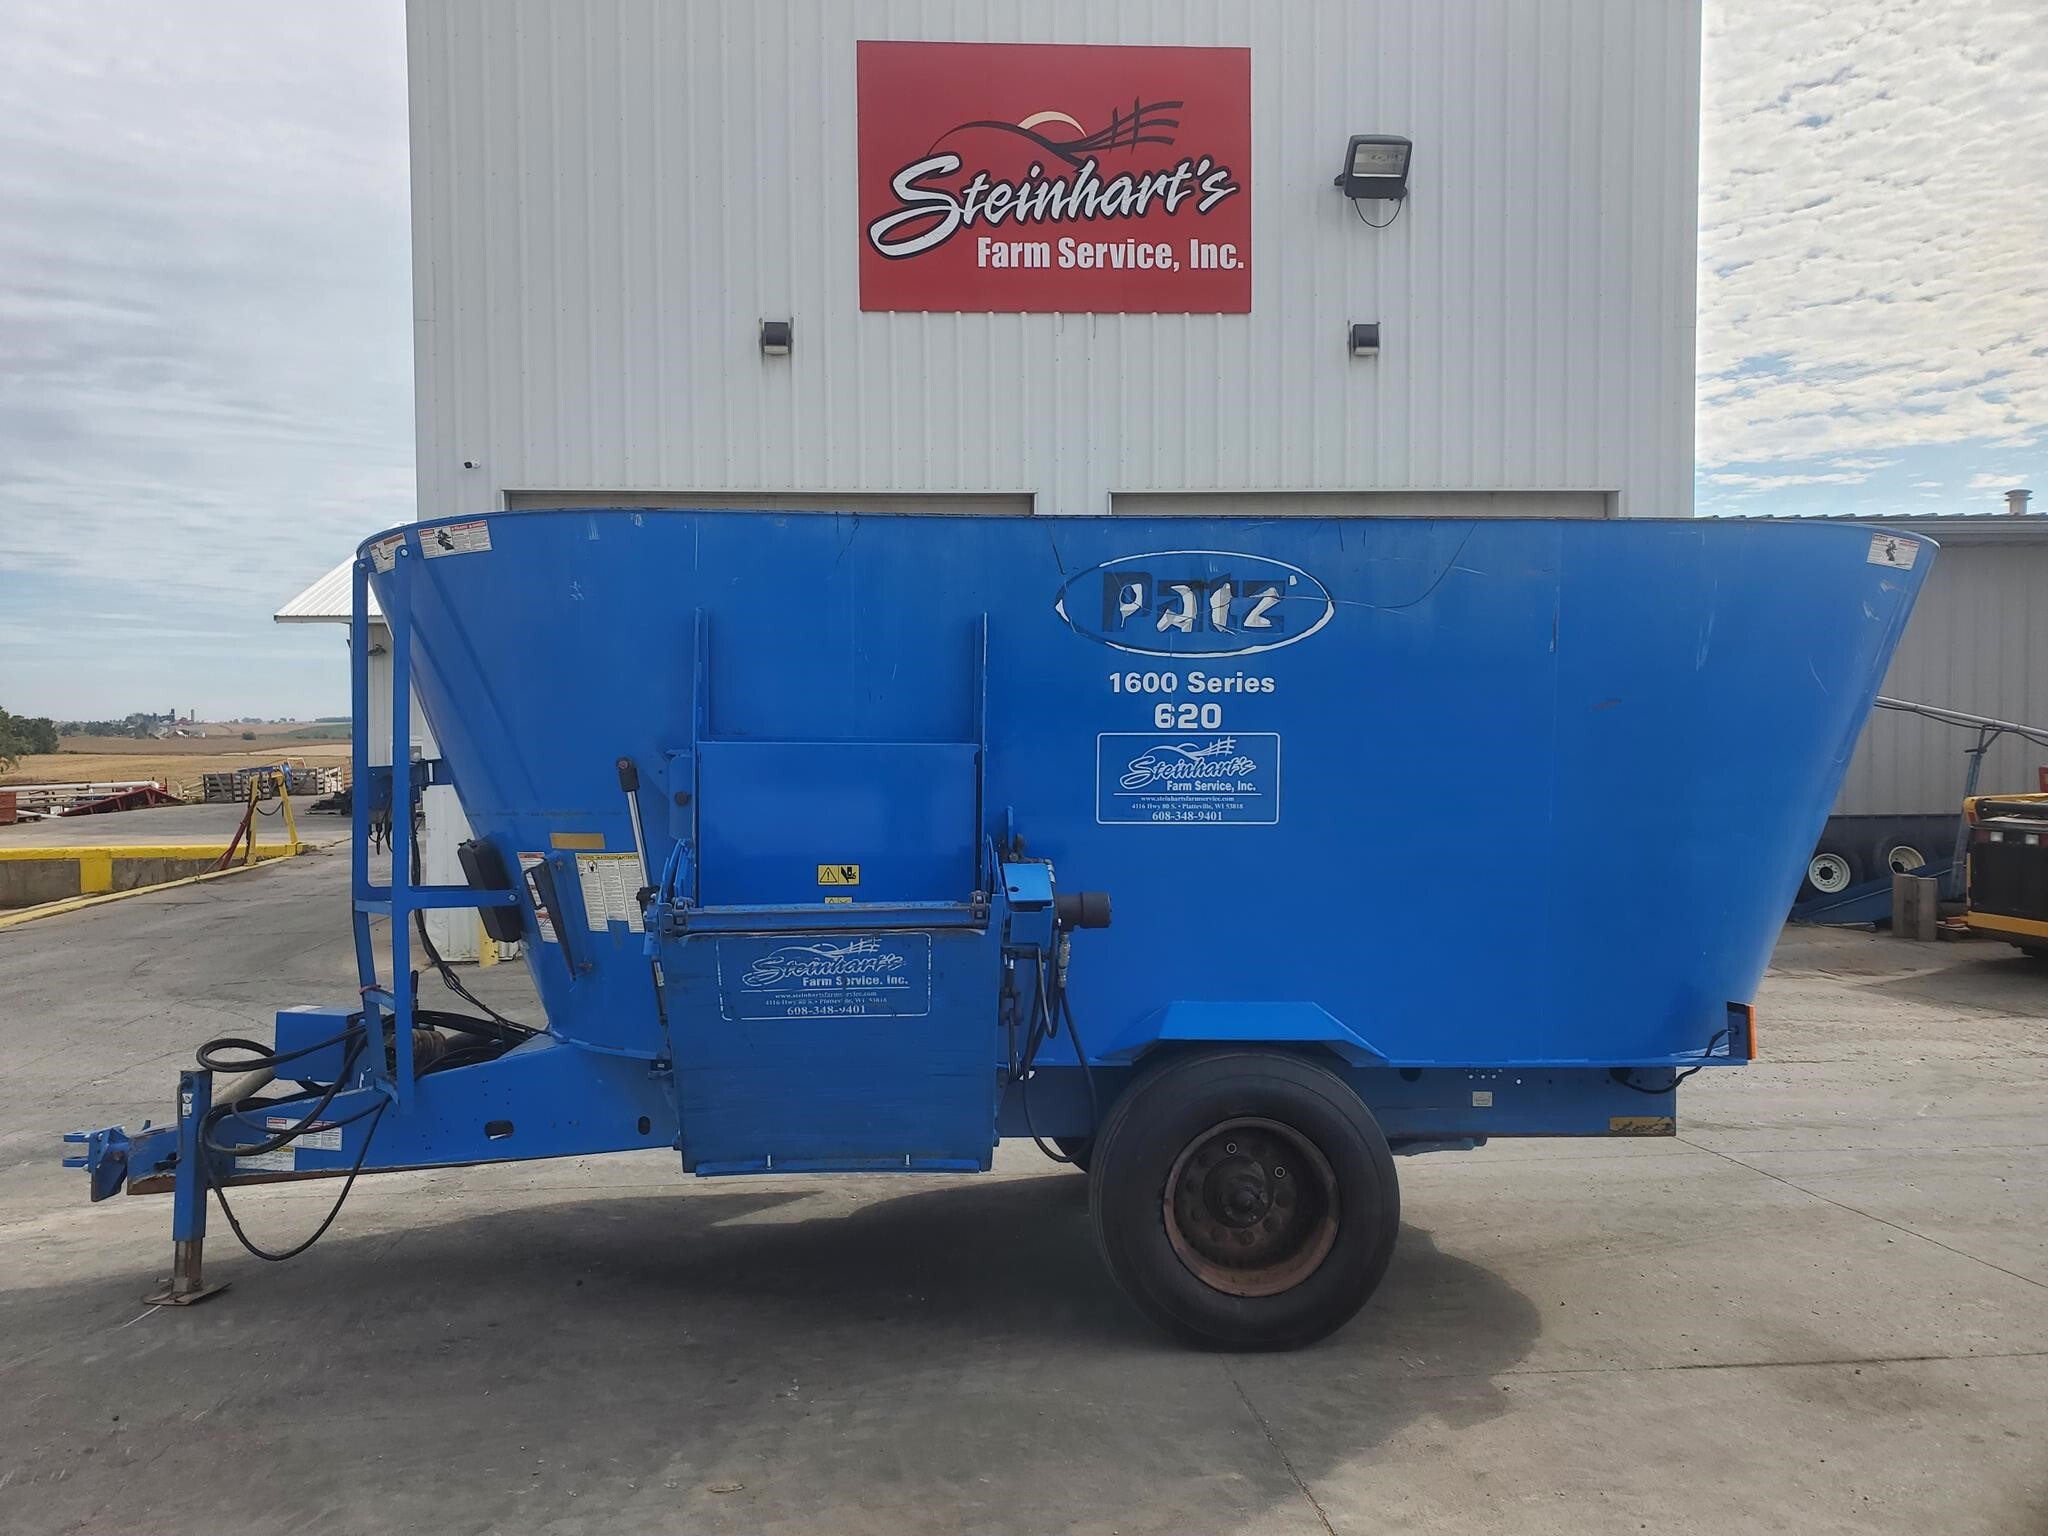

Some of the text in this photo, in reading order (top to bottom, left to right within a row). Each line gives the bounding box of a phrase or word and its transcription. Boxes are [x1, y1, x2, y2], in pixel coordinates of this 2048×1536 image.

[868, 153, 1237, 258] Steinhart's
[978, 237, 1244, 272] Farm Service, Inc.
[1109, 671, 1275, 694] 1600 Series
[1154, 703, 1222, 729] 620
[1120, 756, 1256, 789] Steinhart's
[1167, 781, 1256, 792] Farm Service, Inc.
[1152, 811, 1222, 821] 608-348-9401
[803, 976, 832, 987] Farm
[887, 975, 909, 985] Inc.
